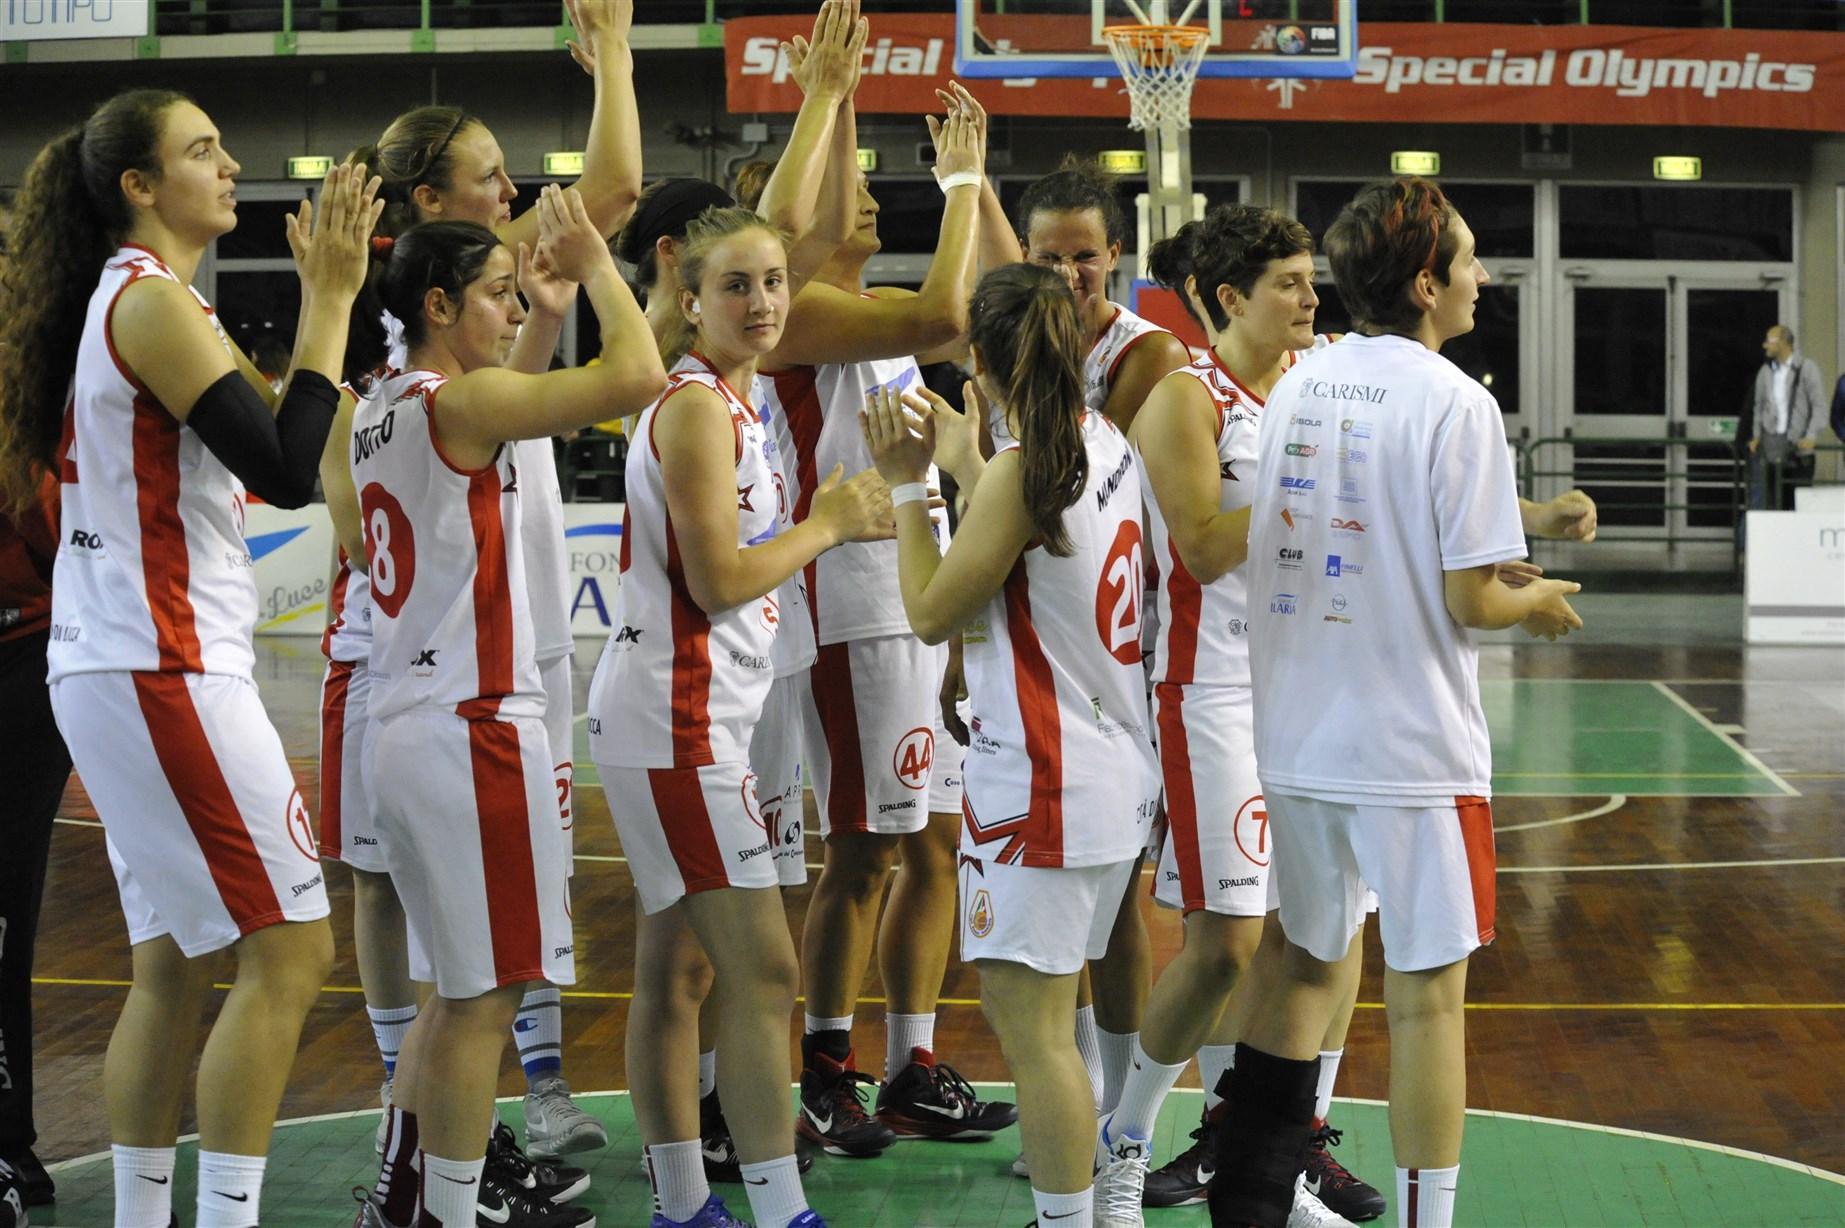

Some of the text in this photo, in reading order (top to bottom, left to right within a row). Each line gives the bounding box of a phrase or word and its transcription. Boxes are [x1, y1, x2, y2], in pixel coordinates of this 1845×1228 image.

[741, 37, 944, 84] Spial
[1352, 46, 1817, 98] Special Olympics
[1312, 381, 1390, 405] CARISMI
[70, 529, 104, 551] RO
[370, 507, 397, 597] 8
[1109, 541, 1143, 654] 20
[900, 737, 930, 781] 44
[879, 799, 917, 814] SPALDING
[1218, 876, 1259, 890] SPALDING
